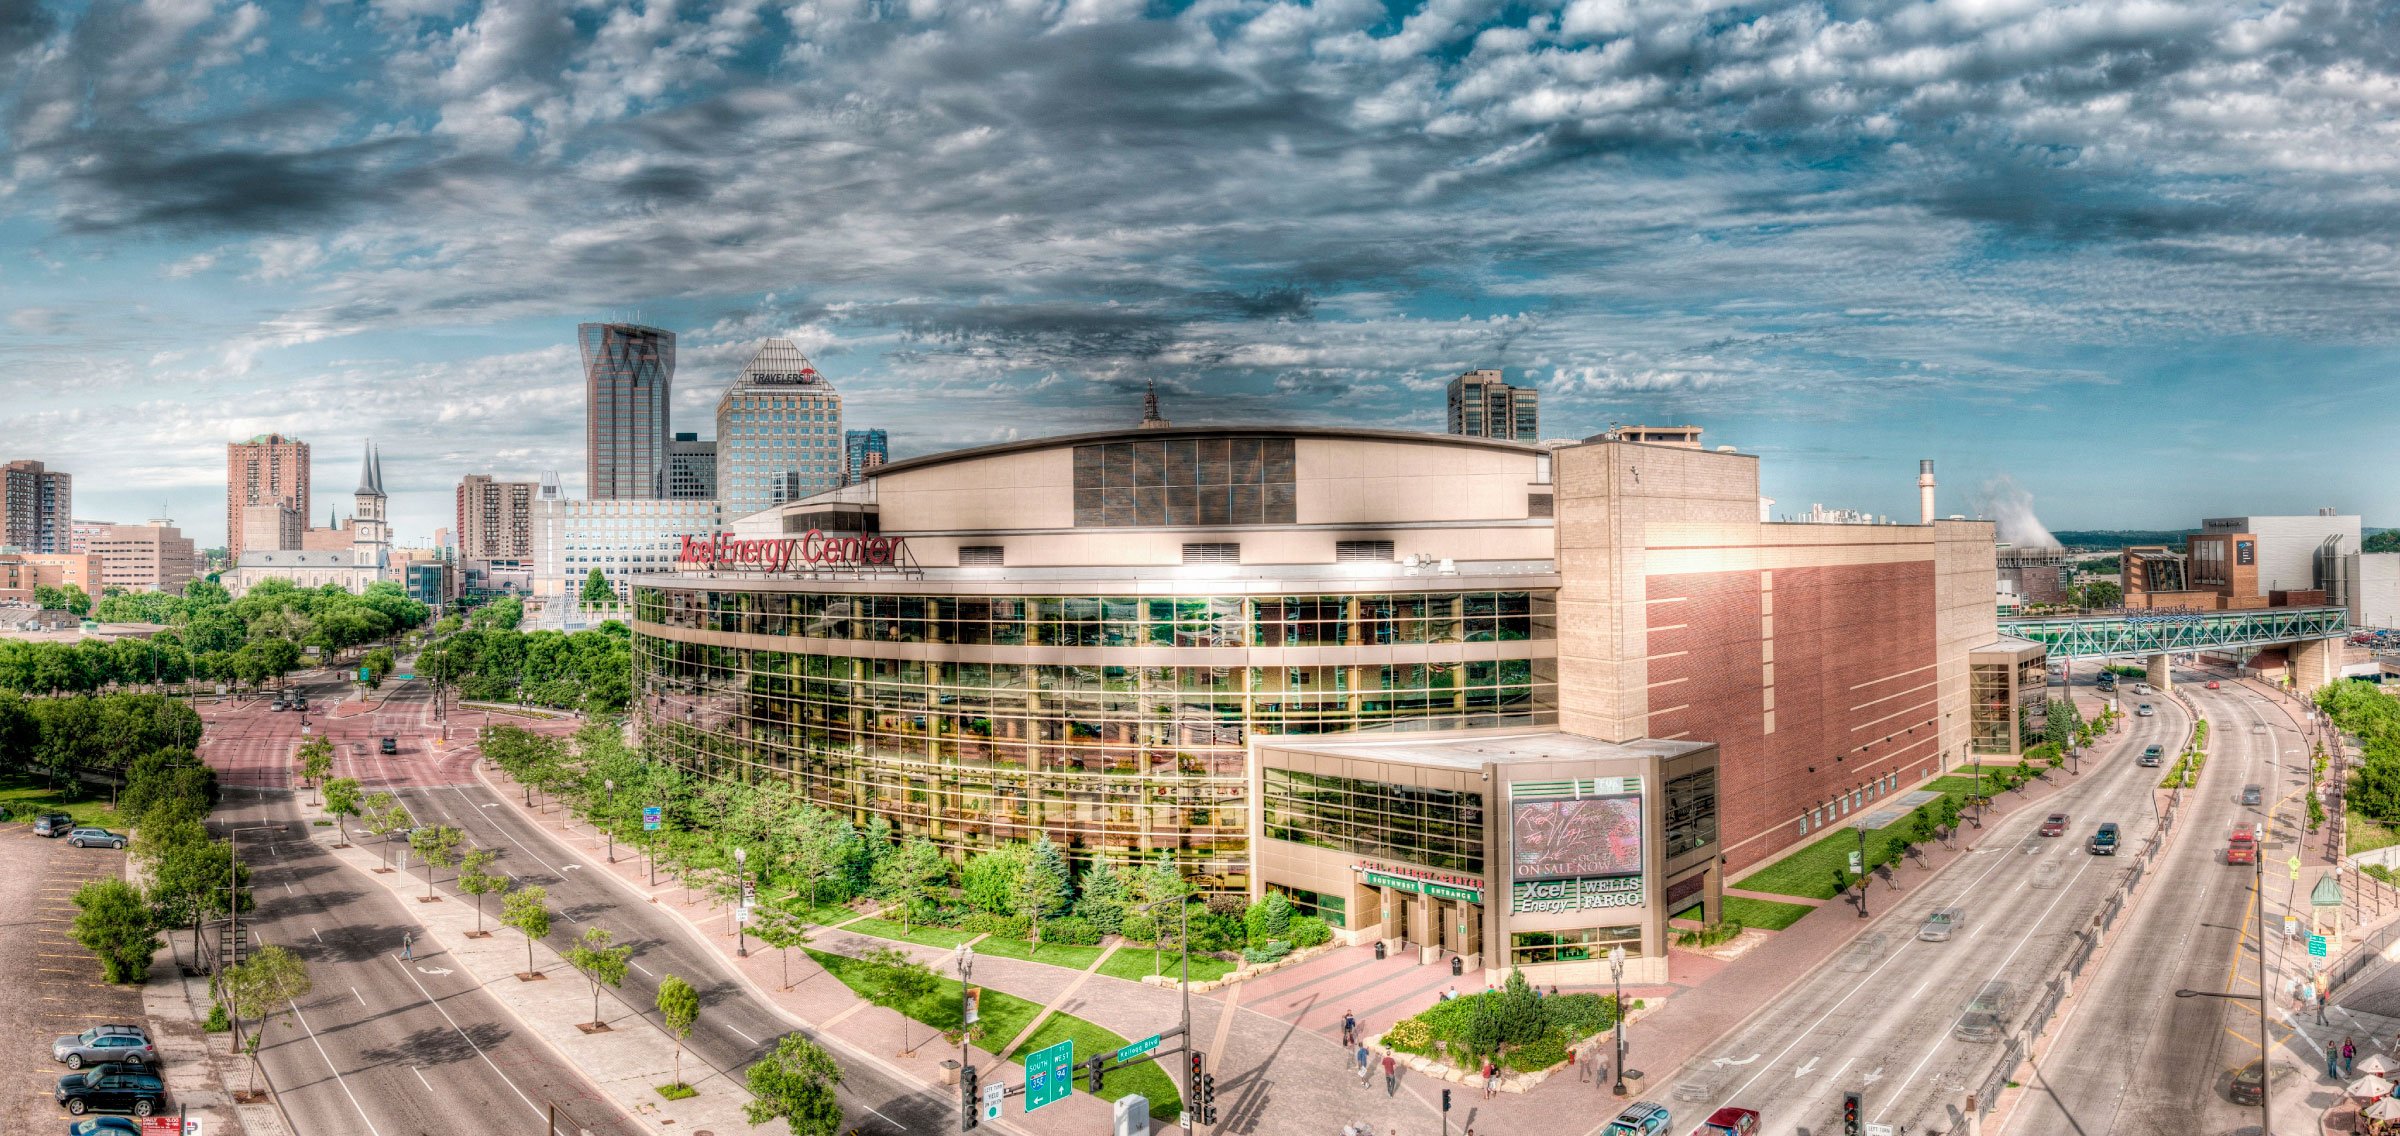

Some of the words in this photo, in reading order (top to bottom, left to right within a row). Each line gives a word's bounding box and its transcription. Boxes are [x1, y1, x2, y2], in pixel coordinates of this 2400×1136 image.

[752, 373, 804, 383] TRAVELERS
[680, 533, 717, 563] Xcel
[720, 533, 796, 573] Energy
[803, 529, 904, 563] Center
[1518, 864, 1540, 876] ON
[1544, 863, 1574, 874] SALE
[1577, 862, 1611, 873] NOW
[1390, 866, 1433, 880] ENERGY
[1440, 874, 1484, 889] CENTER
[1373, 876, 1416, 890] SOUTHWEST
[1431, 887, 1471, 900] ENTRANCE
[1523, 880, 1567, 899] Xcel
[1583, 878, 1640, 894] WELLS
[1521, 899, 1568, 914] Energy
[1583, 893, 1640, 908] FARGO
[1120, 1045, 1143, 1058] Kellogg
[1144, 1038, 1158, 1049] Blvd
[1055, 1052, 1069, 1063] WEST
[1030, 1060, 1048, 1073] SOUTH
[1056, 1069, 1066, 1079] 94
[1032, 1076, 1044, 1089] 35E
